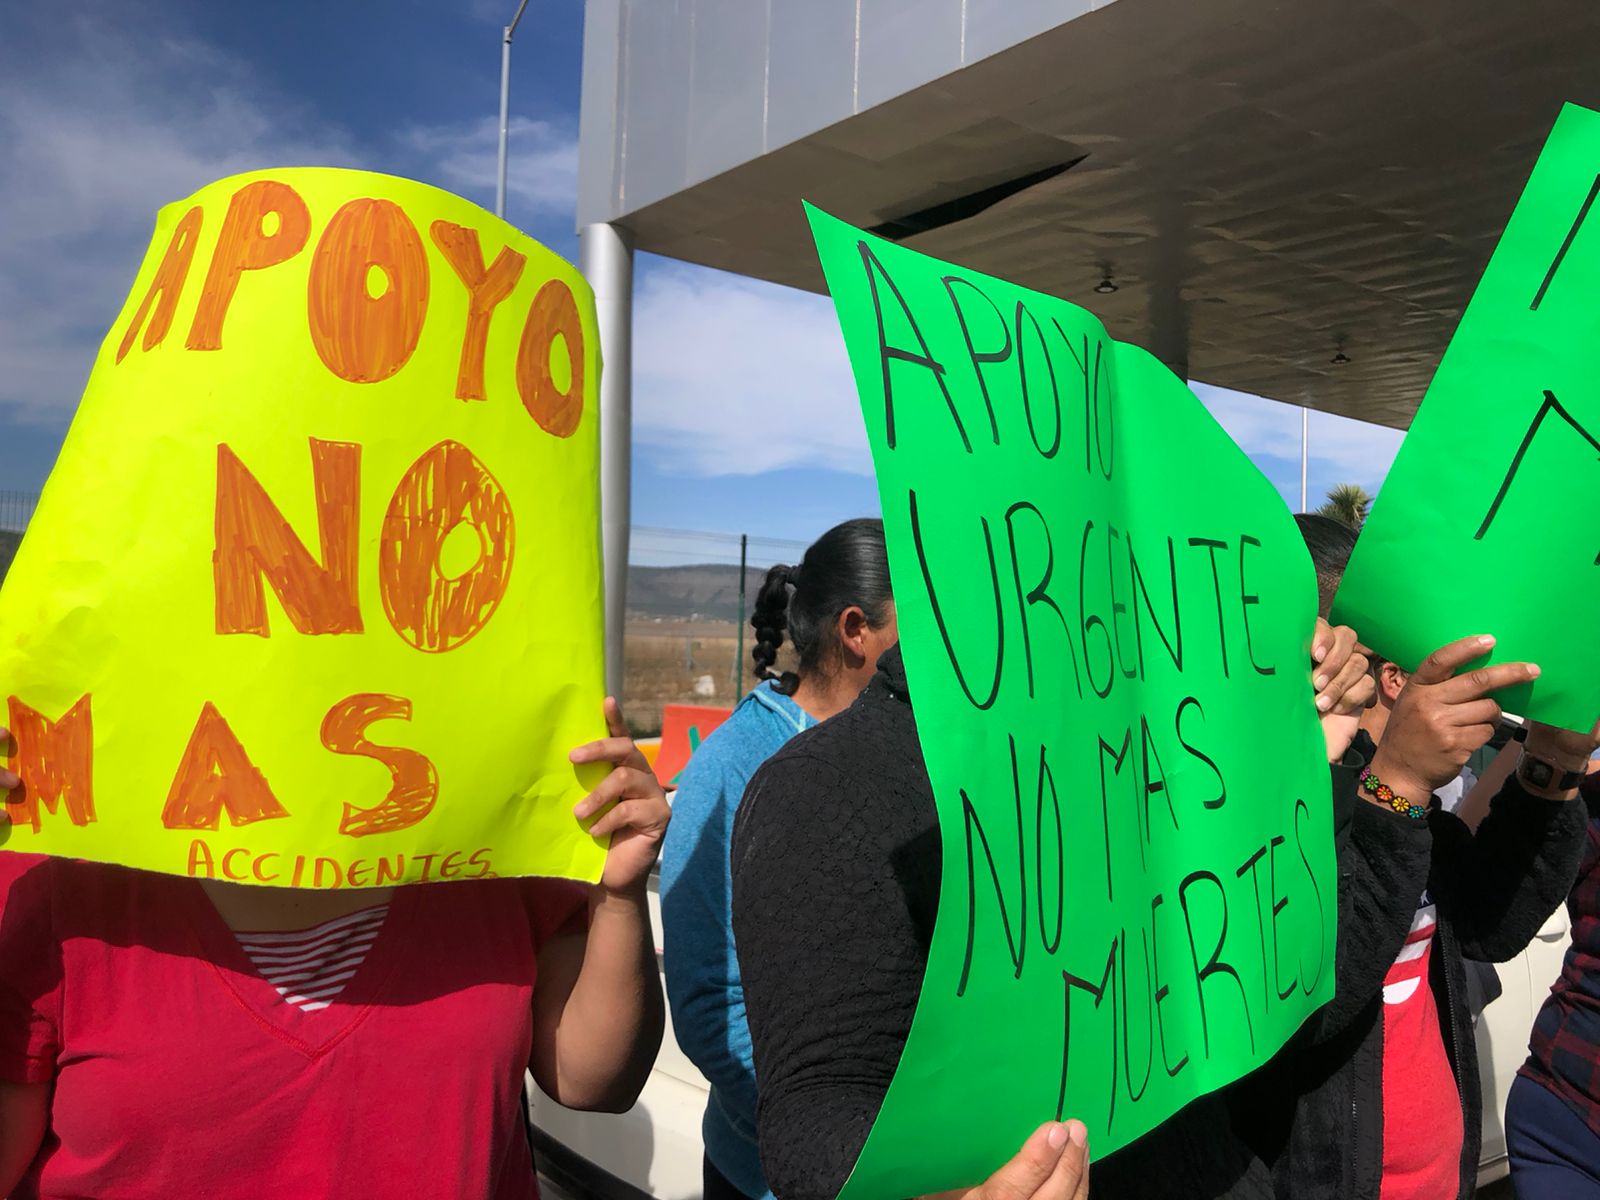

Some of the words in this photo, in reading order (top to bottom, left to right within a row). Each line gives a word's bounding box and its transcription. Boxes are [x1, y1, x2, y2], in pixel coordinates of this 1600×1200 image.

[116, 181, 585, 438] APOYO
[857, 240, 1115, 482] APOYO
[212, 437, 516, 653] NO
[909, 489, 1276, 711] URGENTE
[5, 693, 440, 838] MAS
[187, 840, 498, 886] ACCIDENTES
[956, 733, 1064, 998] NO
[1098, 696, 1227, 903] MAS
[1055, 799, 1325, 1137] MUERTES
